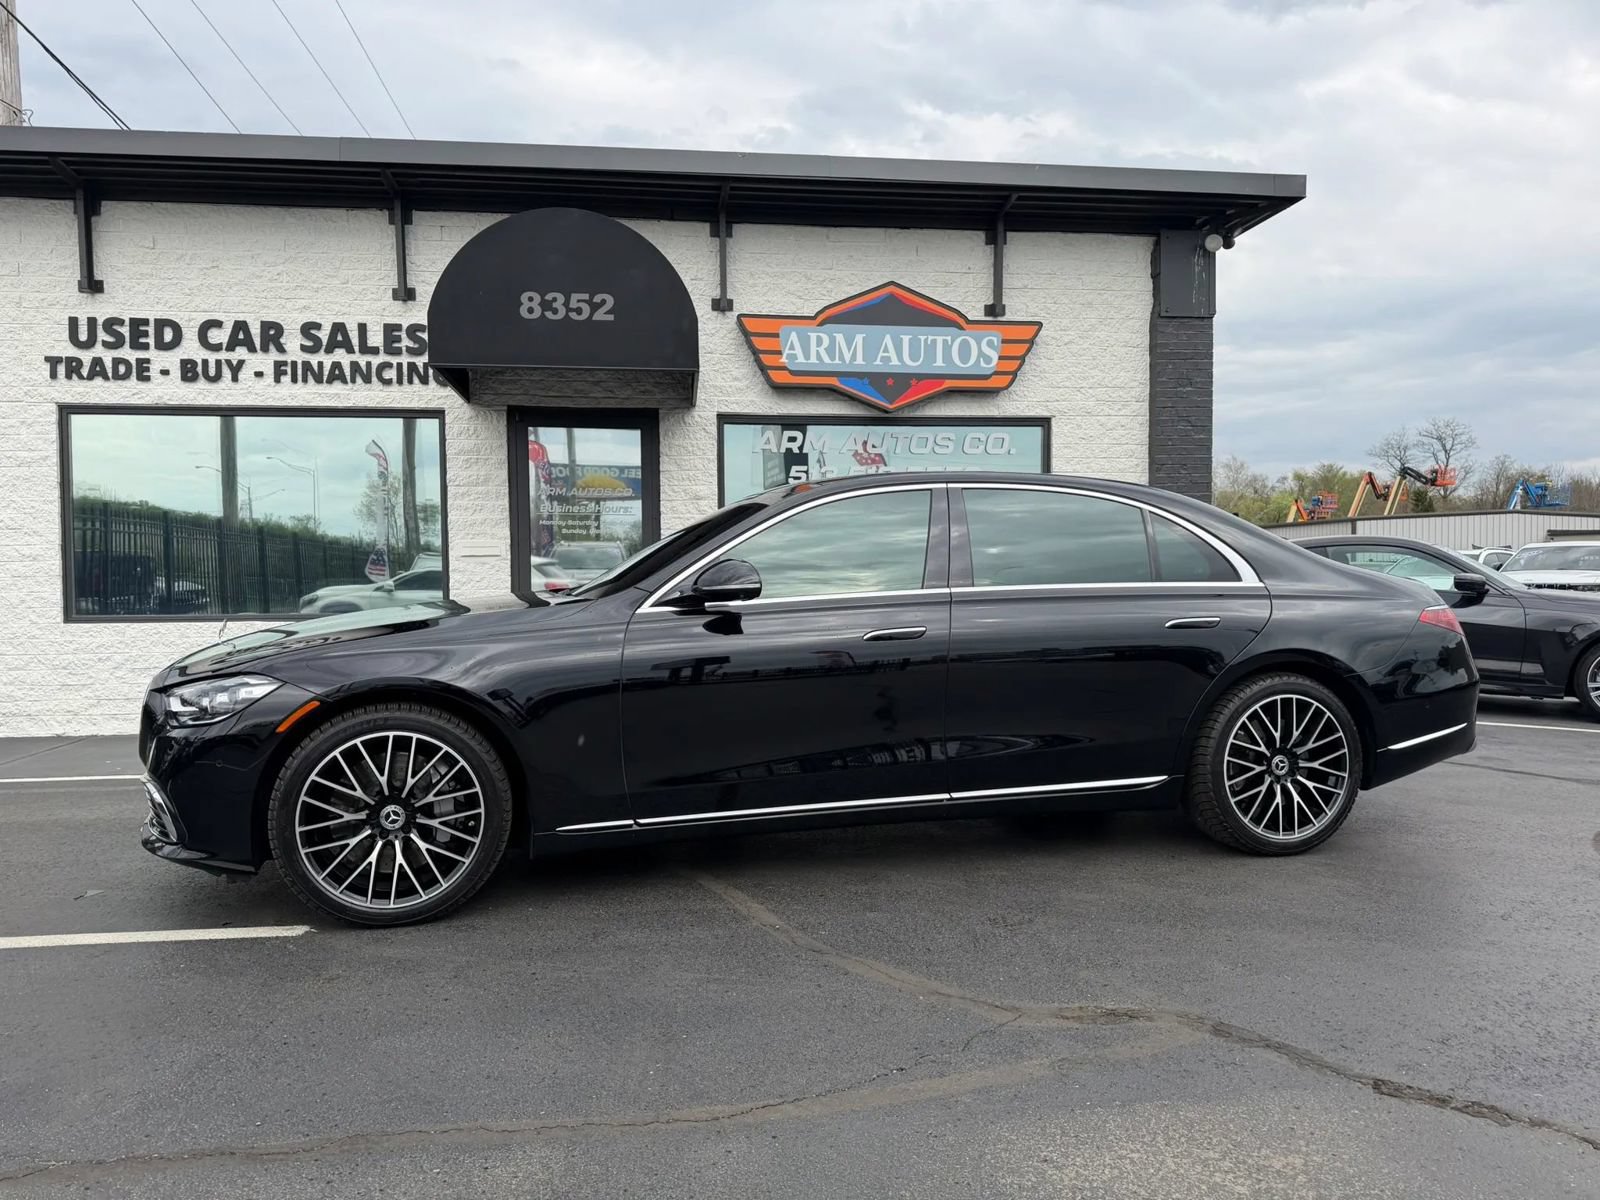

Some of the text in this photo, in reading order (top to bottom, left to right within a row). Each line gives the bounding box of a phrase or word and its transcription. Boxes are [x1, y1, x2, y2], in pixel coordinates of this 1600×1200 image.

[519, 291, 615, 321] 8352
[67, 316, 428, 355] USED CAR SALES
[780, 331, 999, 369] ARM AUTOS
[44, 355, 151, 382] TRADE
[179, 358, 246, 383] BUY
[757, 430, 1017, 455] ARM AUTOS CO.
[537, 487, 567, 497] ARM
[568, 487, 612, 497] AUTOS
